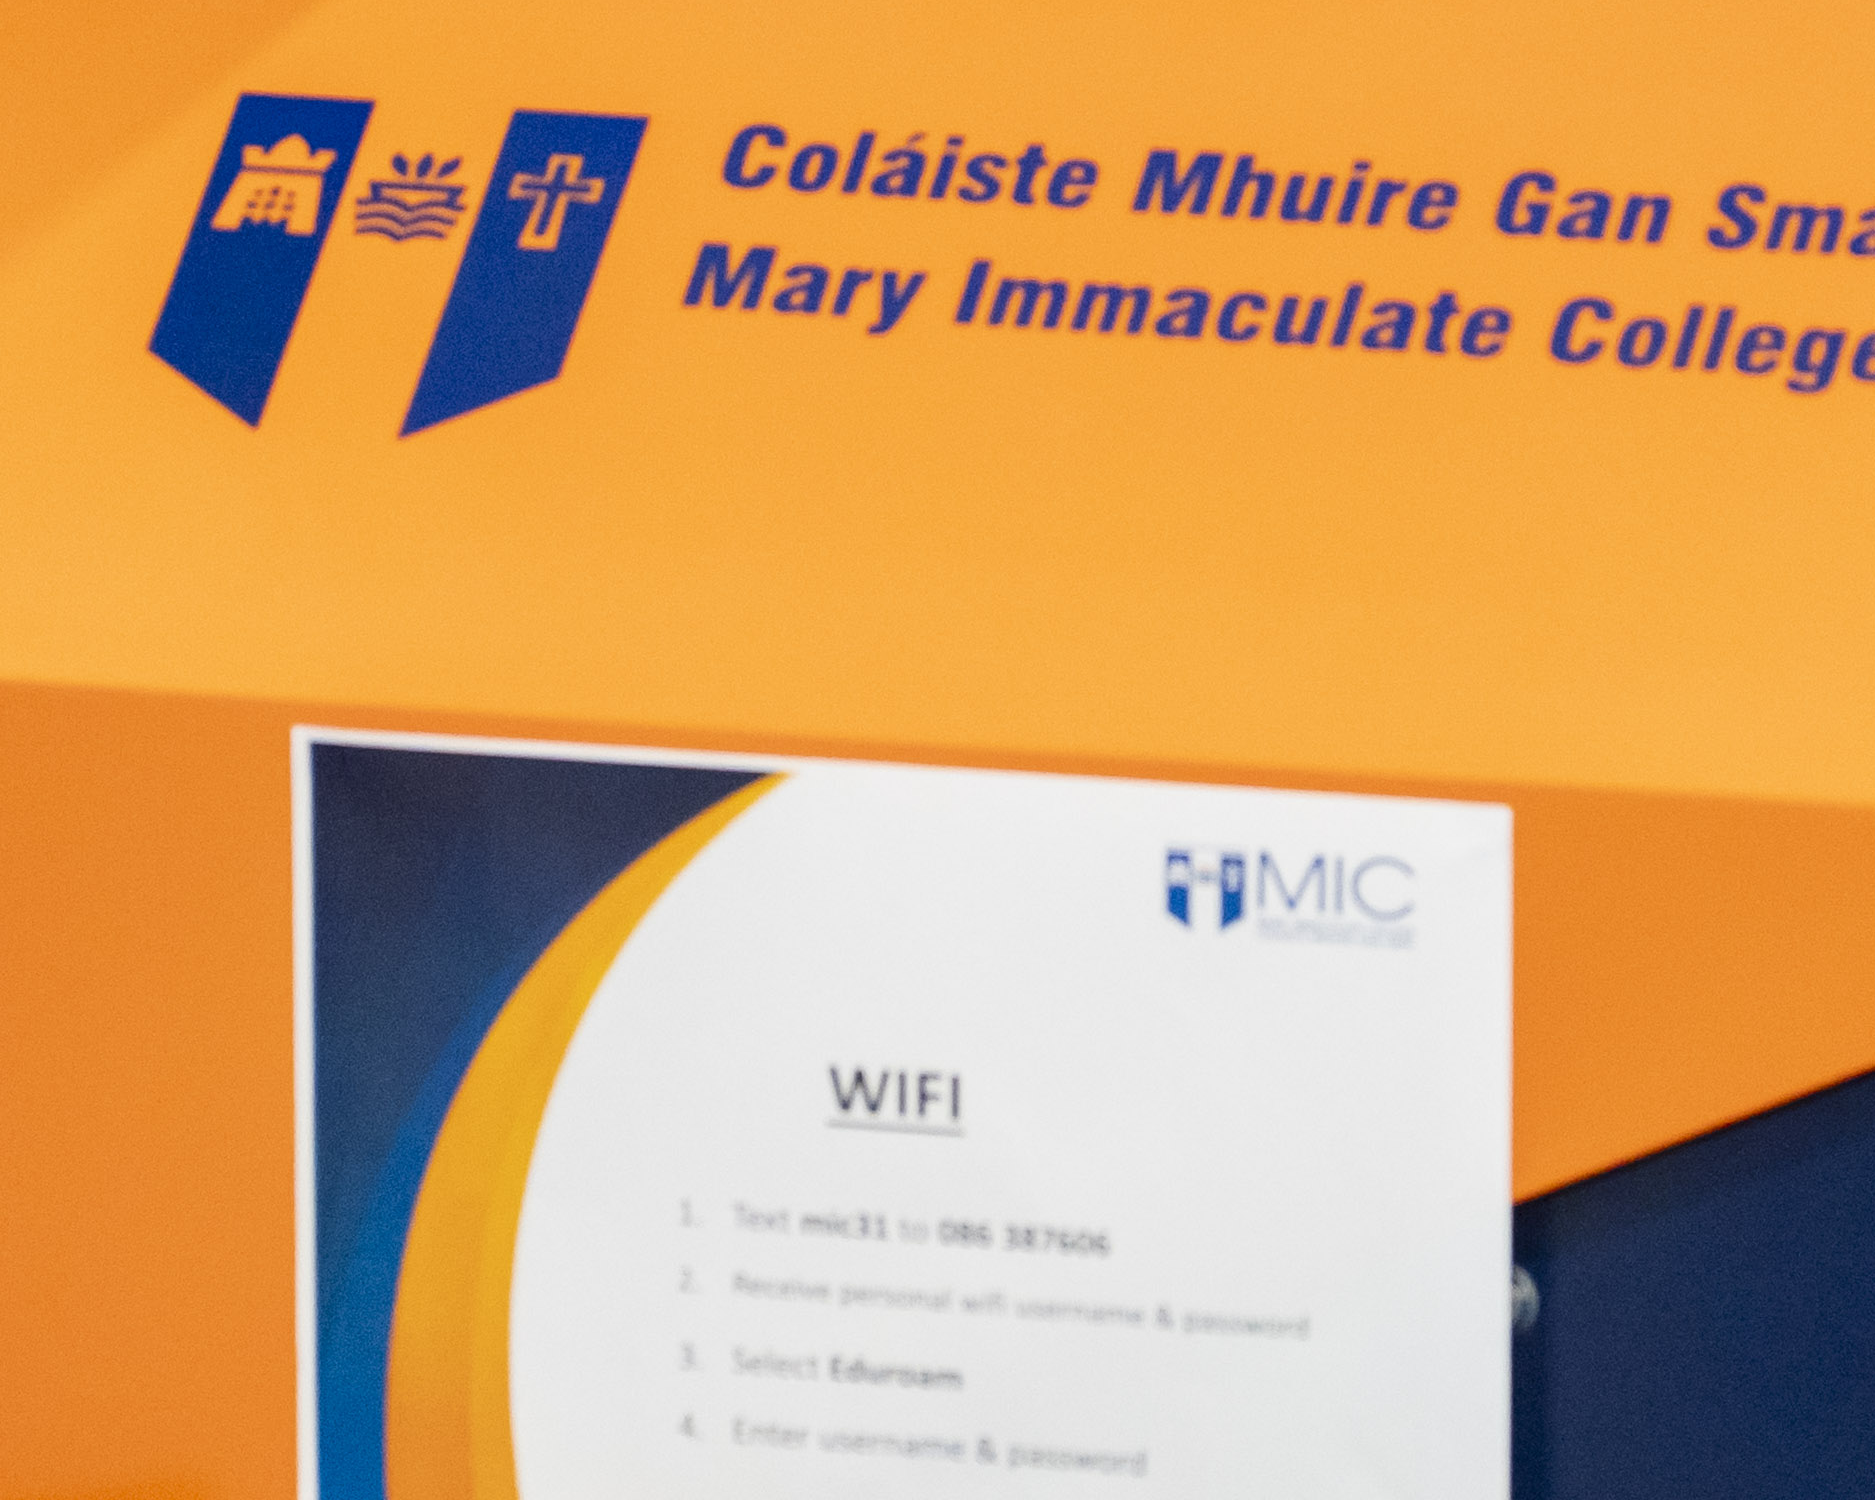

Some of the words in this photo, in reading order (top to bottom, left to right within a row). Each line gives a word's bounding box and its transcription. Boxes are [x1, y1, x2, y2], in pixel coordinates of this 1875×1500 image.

[722, 124, 1099, 208] Coláiste
[1132, 149, 1459, 231] Mhuire
[1495, 171, 1671, 244] Gan
[683, 243, 925, 335] Mary
[955, 260, 1511, 358] Immaculate
[1256, 850, 1416, 921] MIC
[828, 1065, 963, 1120] WIFI
[732, 1199, 790, 1233] Text
[896, 1215, 931, 1246] to
[731, 1346, 817, 1381] Select
[828, 1354, 966, 1391] Eduroam
[731, 1415, 810, 1449] Enter
[818, 1428, 966, 1464] username
[1006, 1443, 1151, 1480] password
